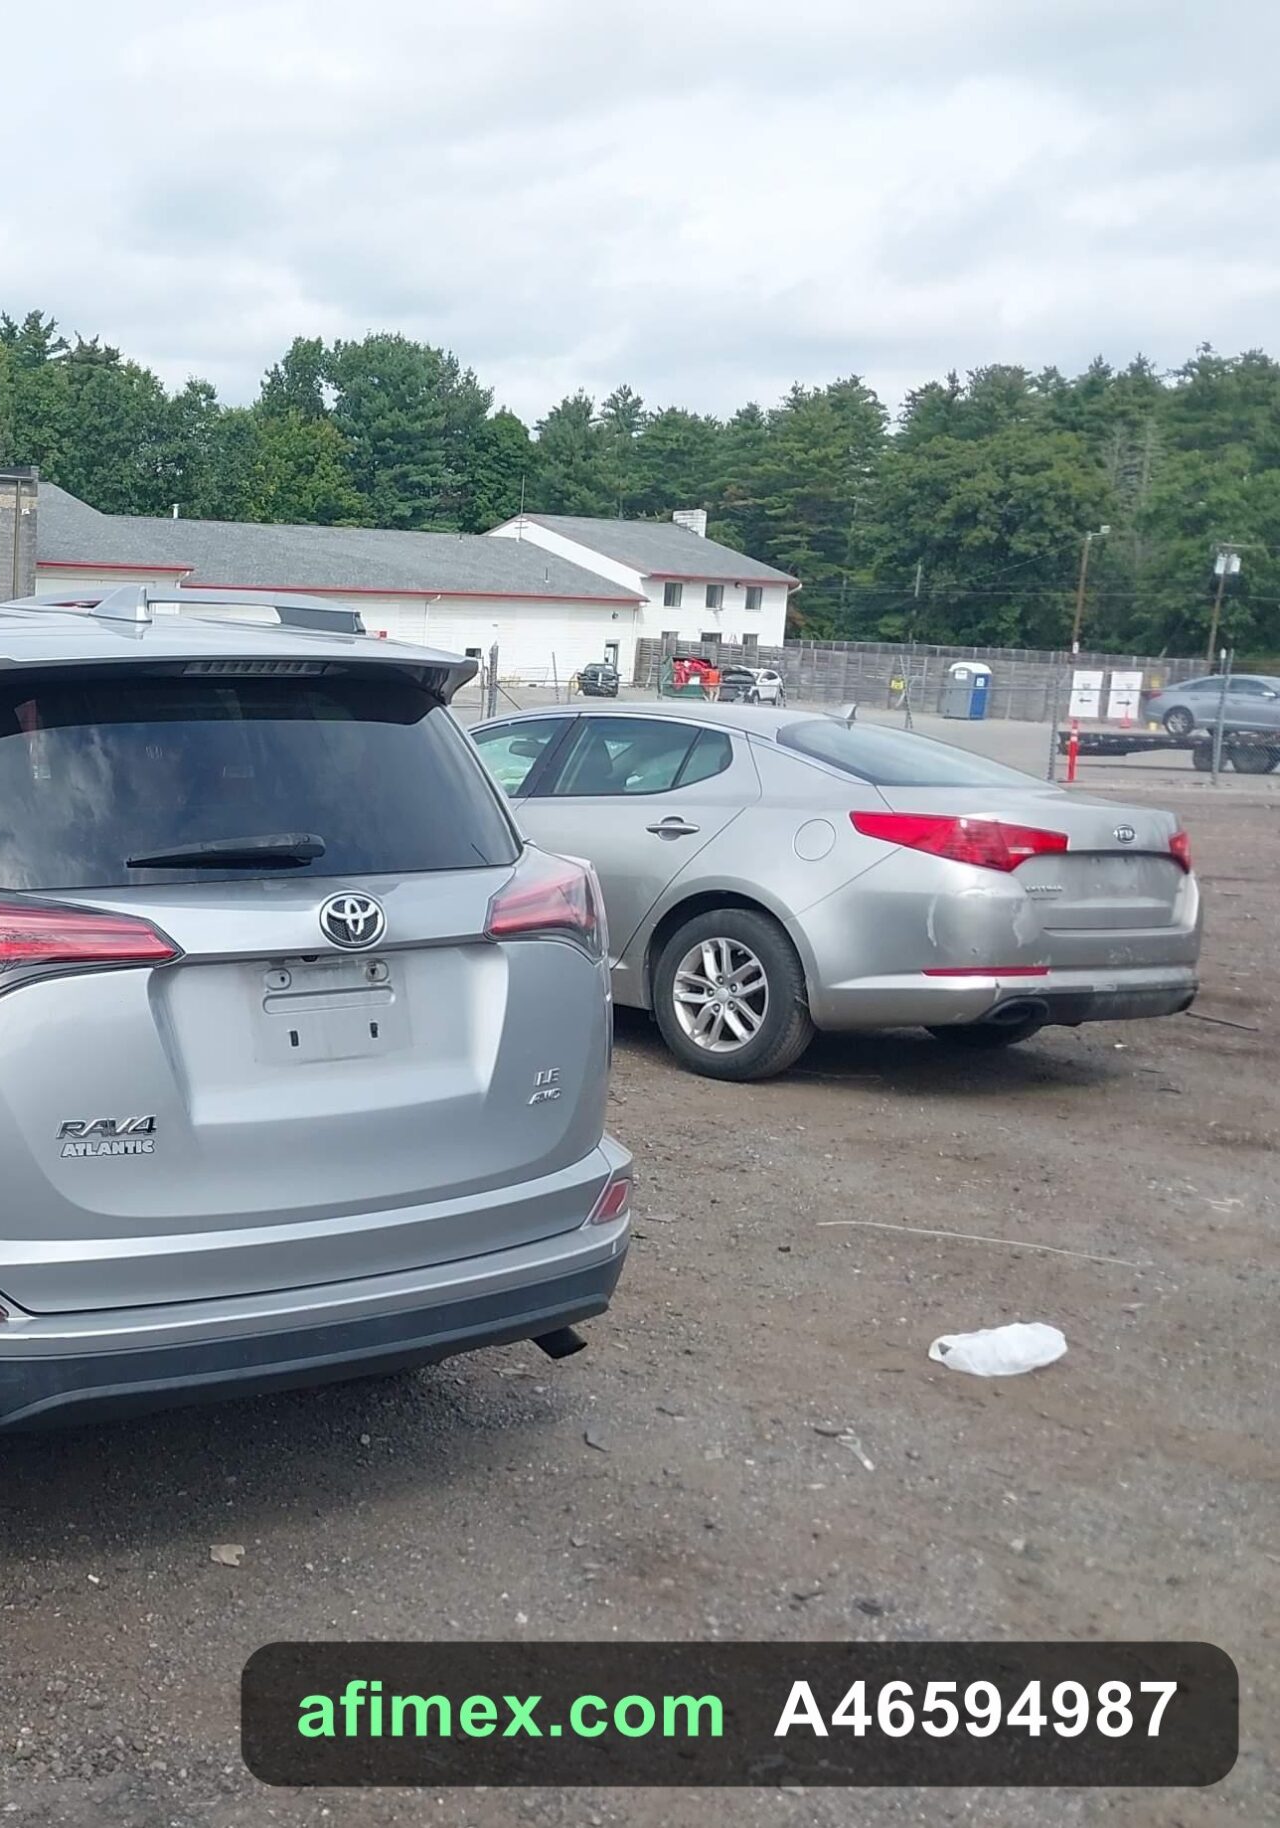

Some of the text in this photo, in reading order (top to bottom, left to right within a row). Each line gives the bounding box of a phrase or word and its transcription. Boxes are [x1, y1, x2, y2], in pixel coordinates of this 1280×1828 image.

[534, 1067, 560, 1087] LE
[56, 1114, 157, 1139] RAV4
[60, 1139, 155, 1157] ATLANTIC
